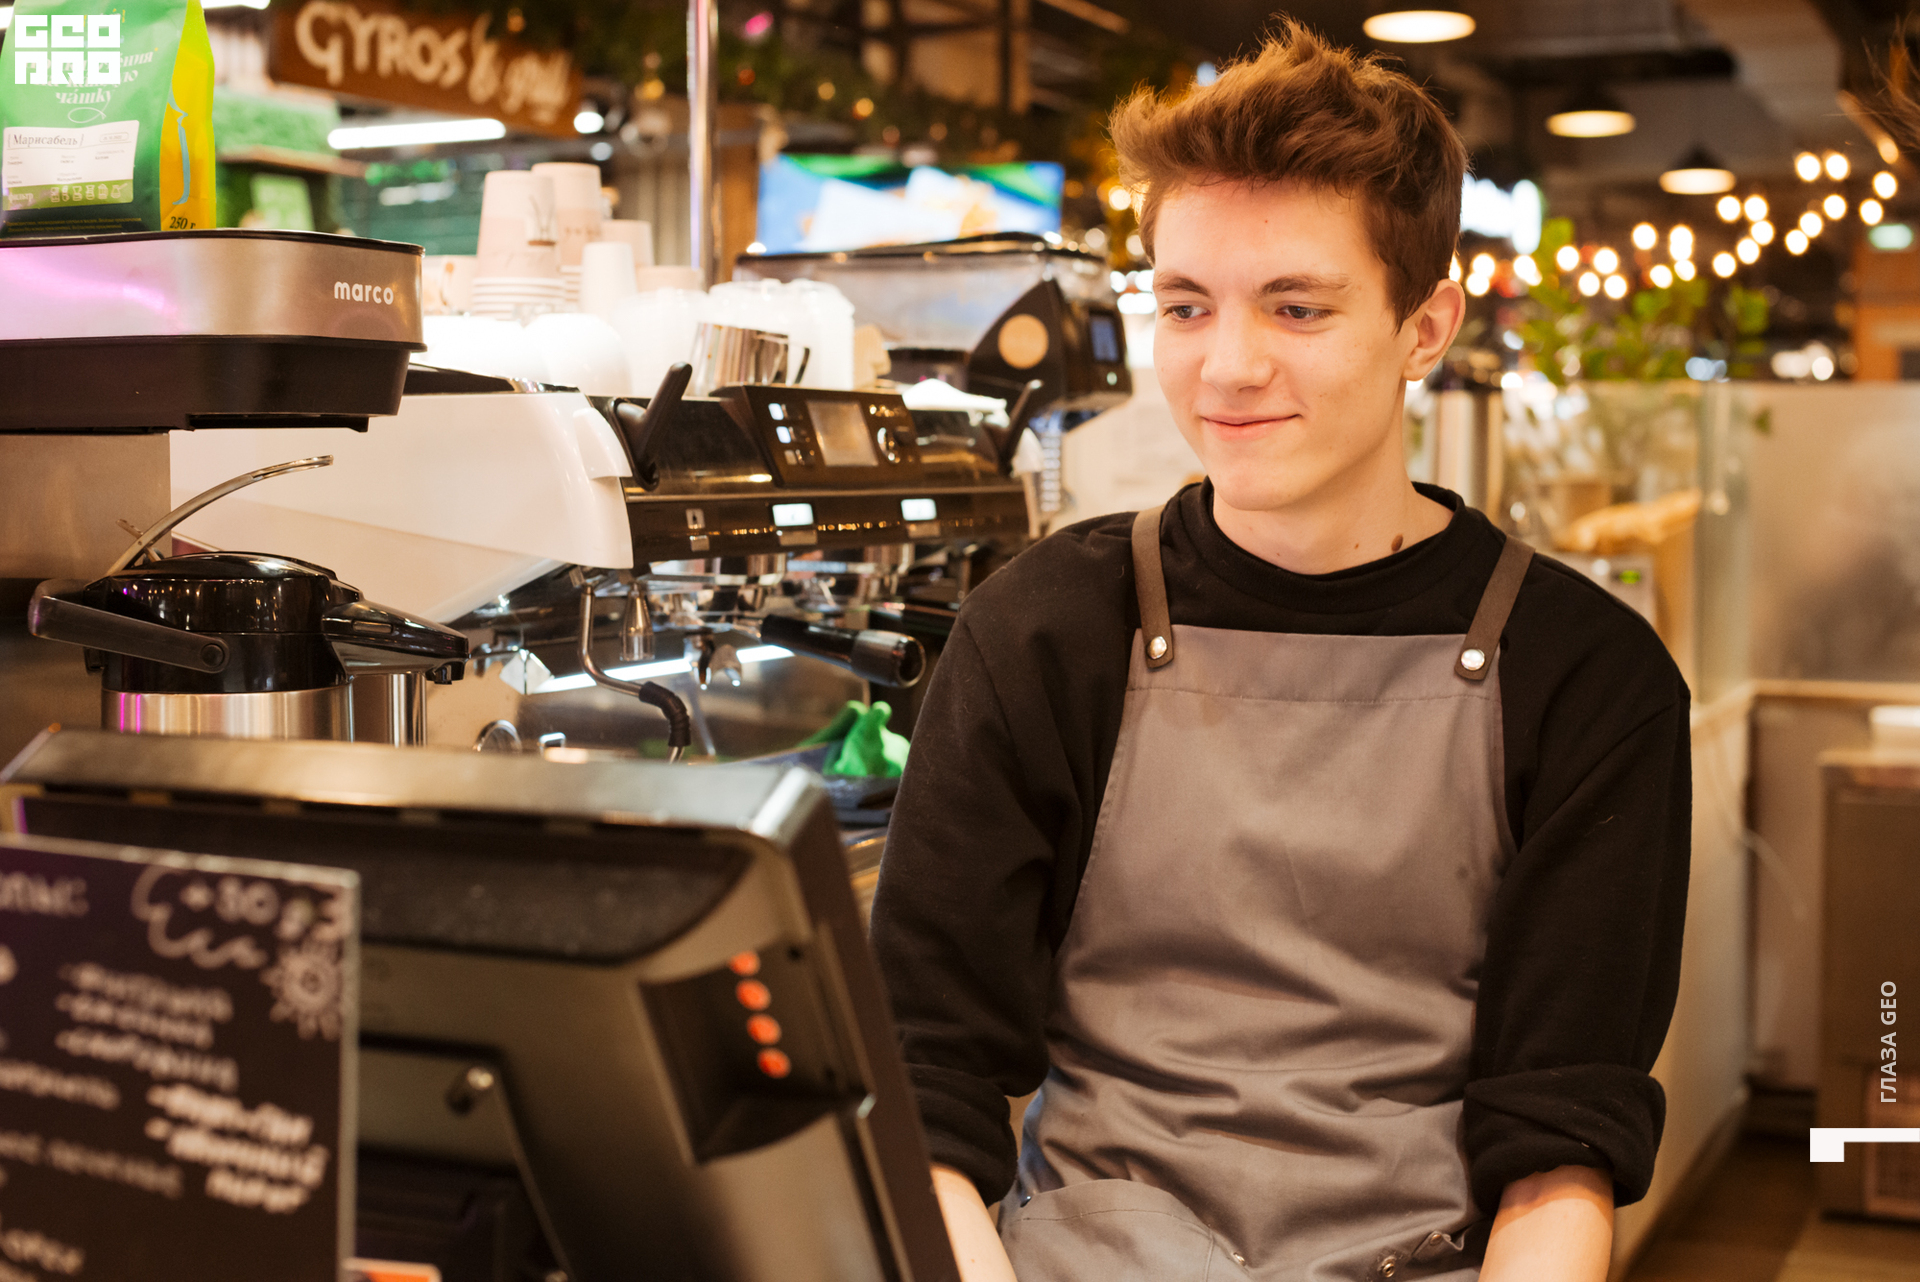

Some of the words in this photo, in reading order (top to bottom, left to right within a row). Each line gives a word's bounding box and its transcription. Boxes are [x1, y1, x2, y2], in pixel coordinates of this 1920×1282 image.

[294, 1, 468, 87] GYROS
[169, 216, 188, 230] 250
[334, 280, 394, 305] marco
